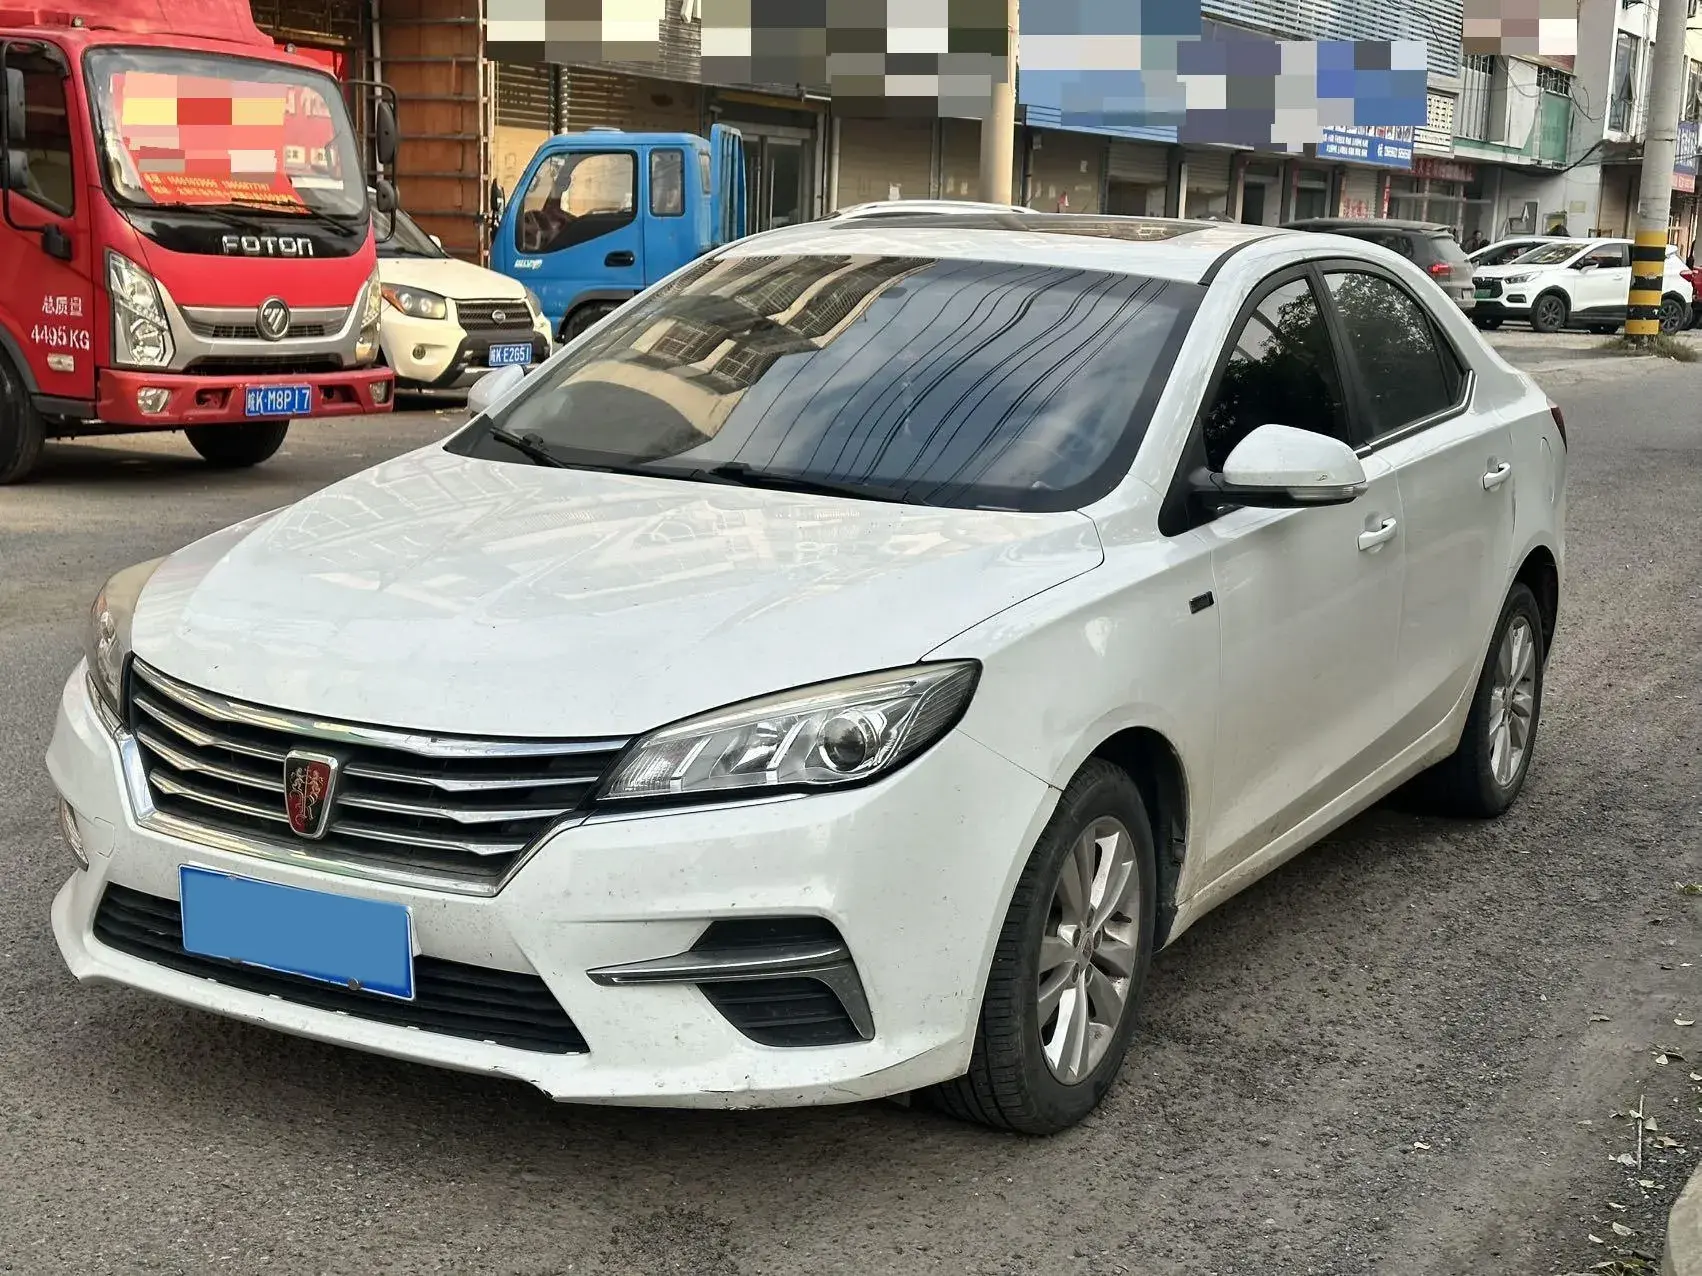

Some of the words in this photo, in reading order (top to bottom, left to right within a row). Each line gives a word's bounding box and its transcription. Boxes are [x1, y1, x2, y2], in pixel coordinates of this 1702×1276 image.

[222, 235, 313, 256] FOTON
[42, 294, 83, 316] 总质量
